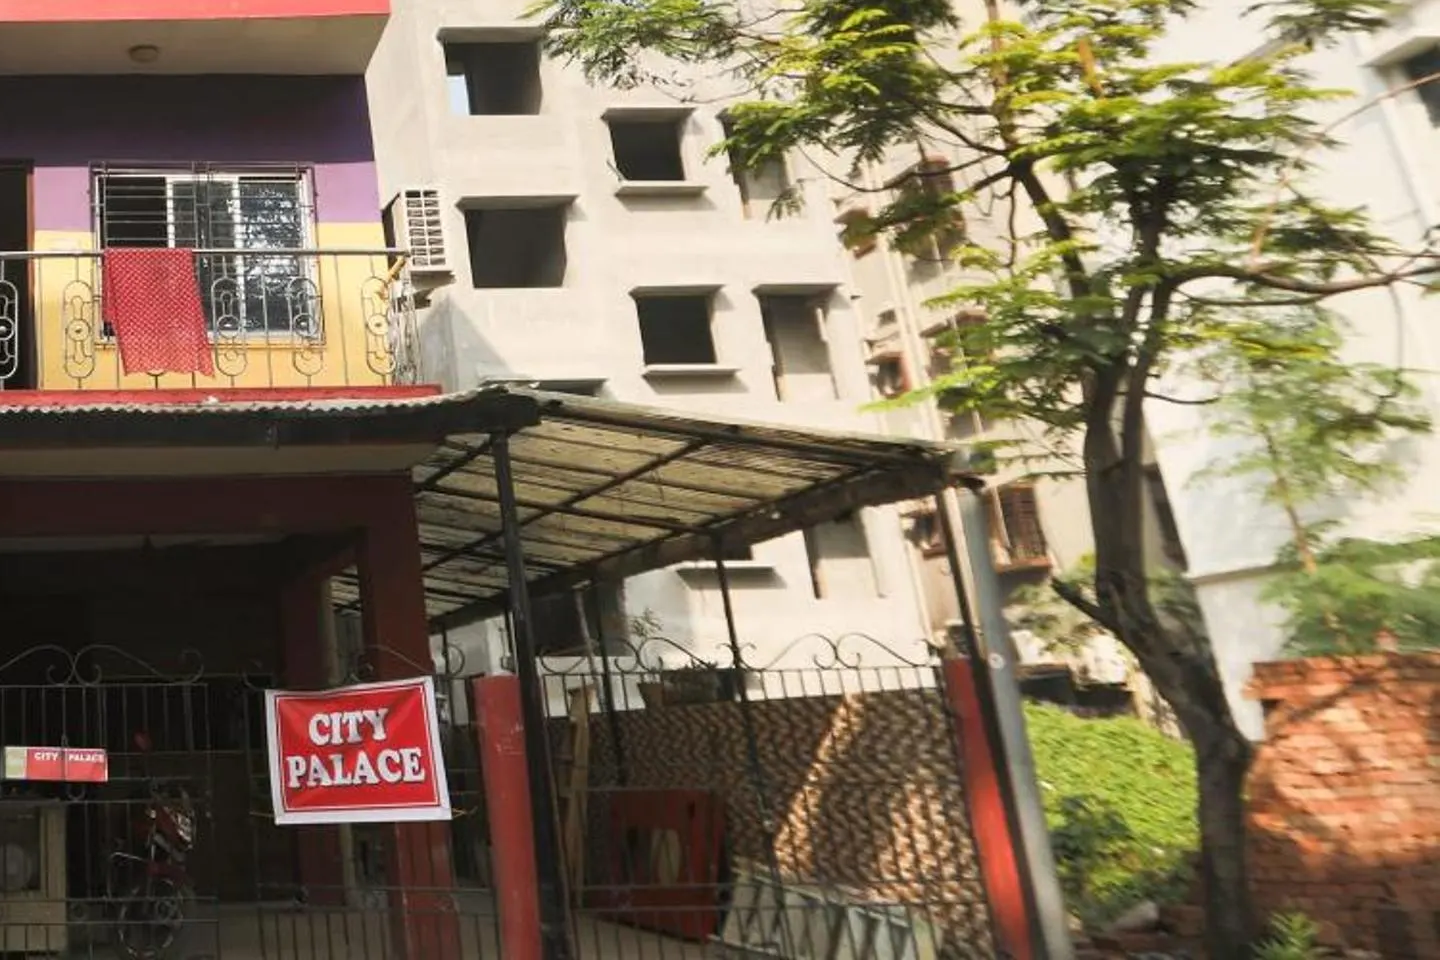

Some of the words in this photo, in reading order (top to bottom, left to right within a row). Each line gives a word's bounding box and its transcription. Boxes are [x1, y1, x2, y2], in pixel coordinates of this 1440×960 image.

[309, 708, 389, 746] CITY
[34, 751, 59, 761] CITY
[68, 753, 105, 763] PALACE
[286, 747, 425, 788] PALACE
